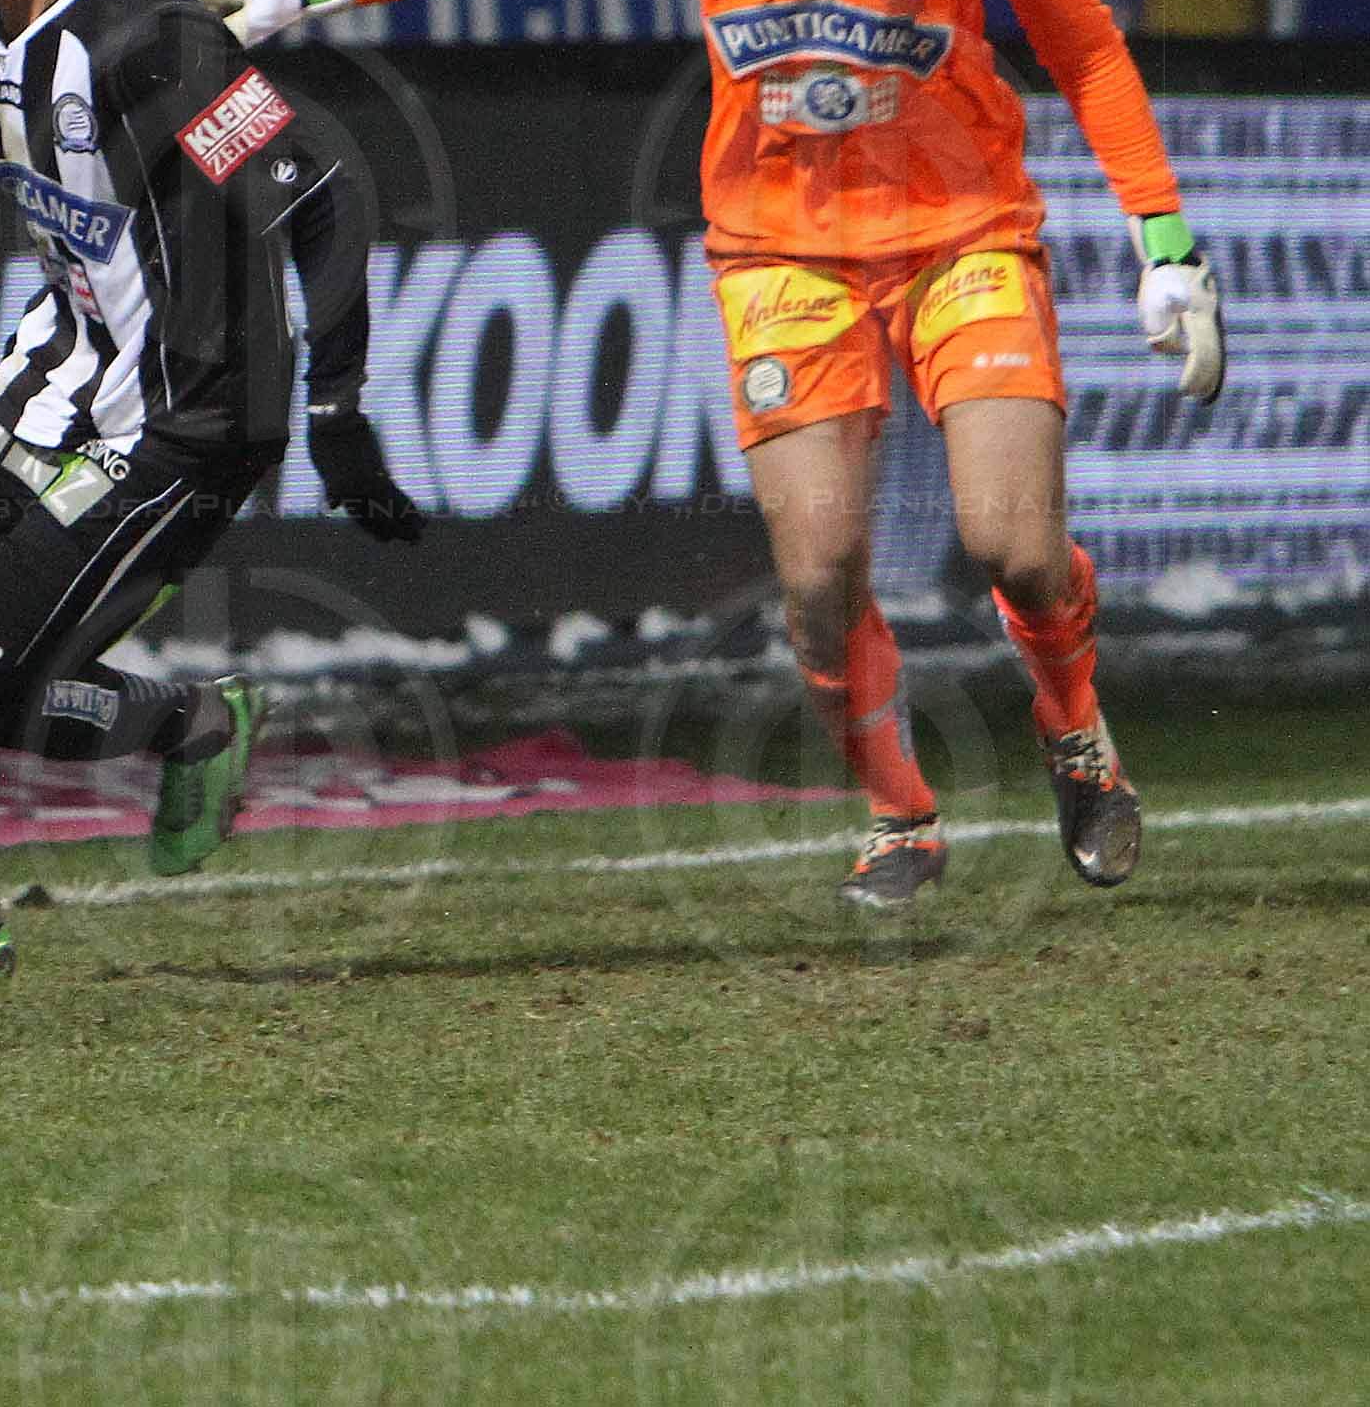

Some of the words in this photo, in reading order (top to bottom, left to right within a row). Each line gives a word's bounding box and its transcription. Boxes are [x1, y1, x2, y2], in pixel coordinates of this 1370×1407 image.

[720, 11, 937, 60] PUNTIGAMER
[183, 73, 275, 156] KLEINE
[212, 98, 289, 175] ZEITUNG
[15, 179, 111, 248] GAMER
